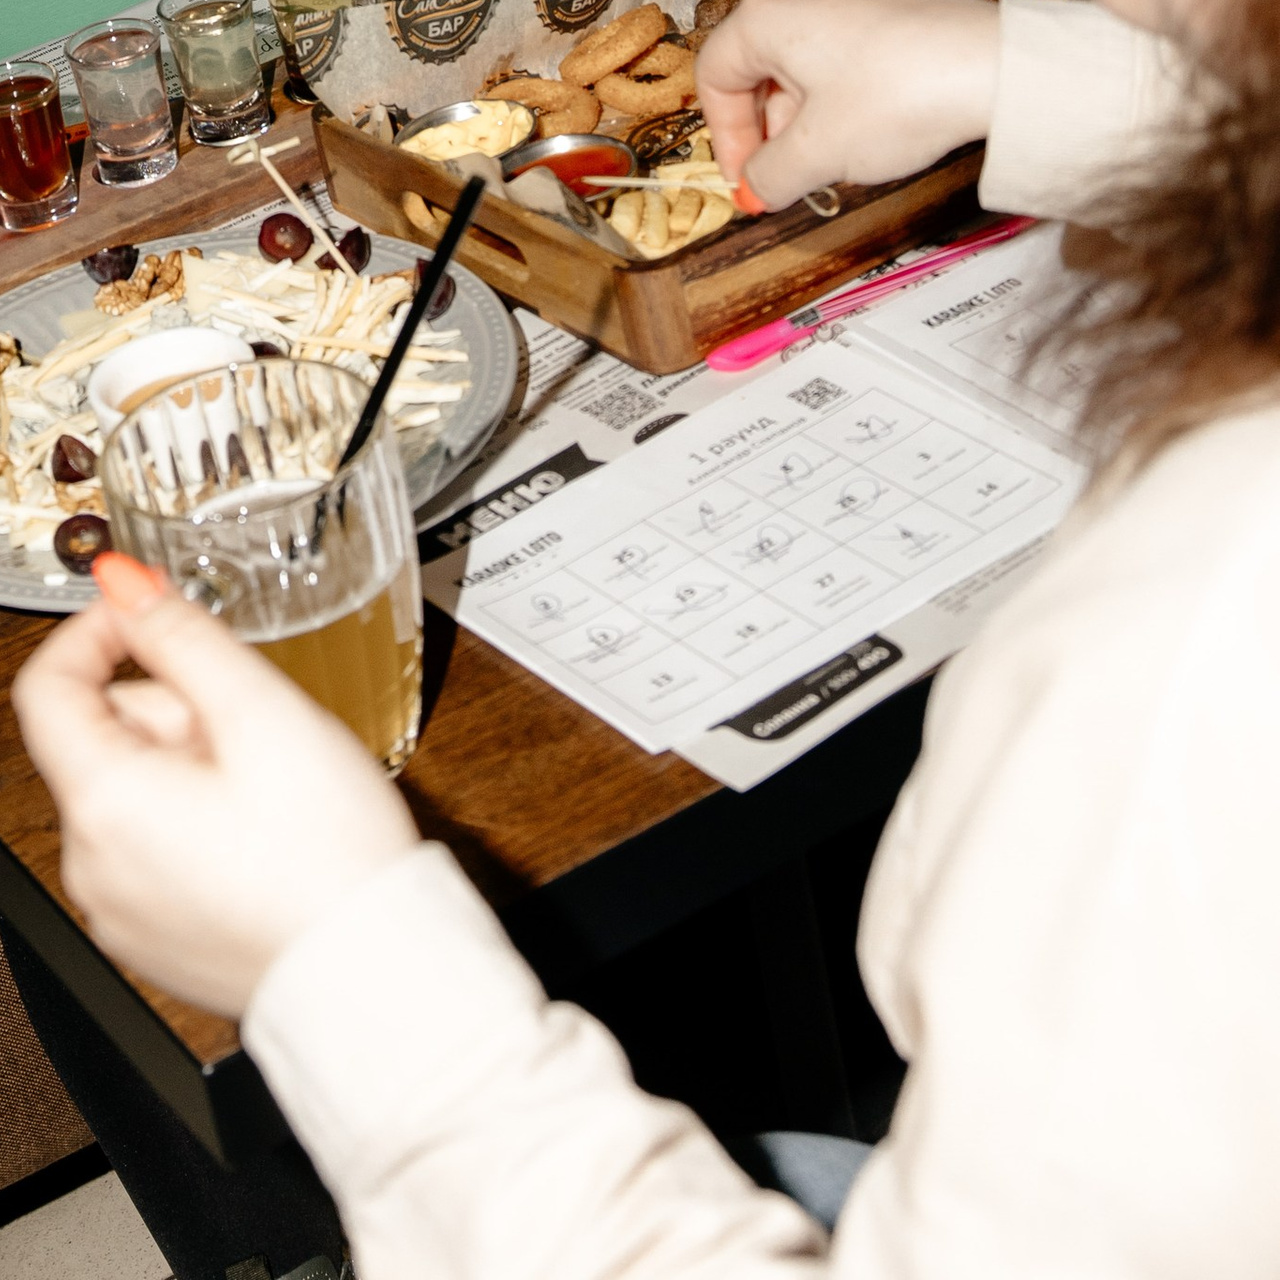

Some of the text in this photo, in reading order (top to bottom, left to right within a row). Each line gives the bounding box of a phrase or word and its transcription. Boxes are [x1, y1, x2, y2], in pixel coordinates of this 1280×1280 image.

[428, 15, 465, 38] БАР
[922, 294, 990, 329] KARAOKE
[983, 277, 1022, 300] LOTO
[689, 417, 776, 465] 1 раунд
[437, 470, 566, 547] МЕНЮ
[521, 531, 563, 557] LOTO
